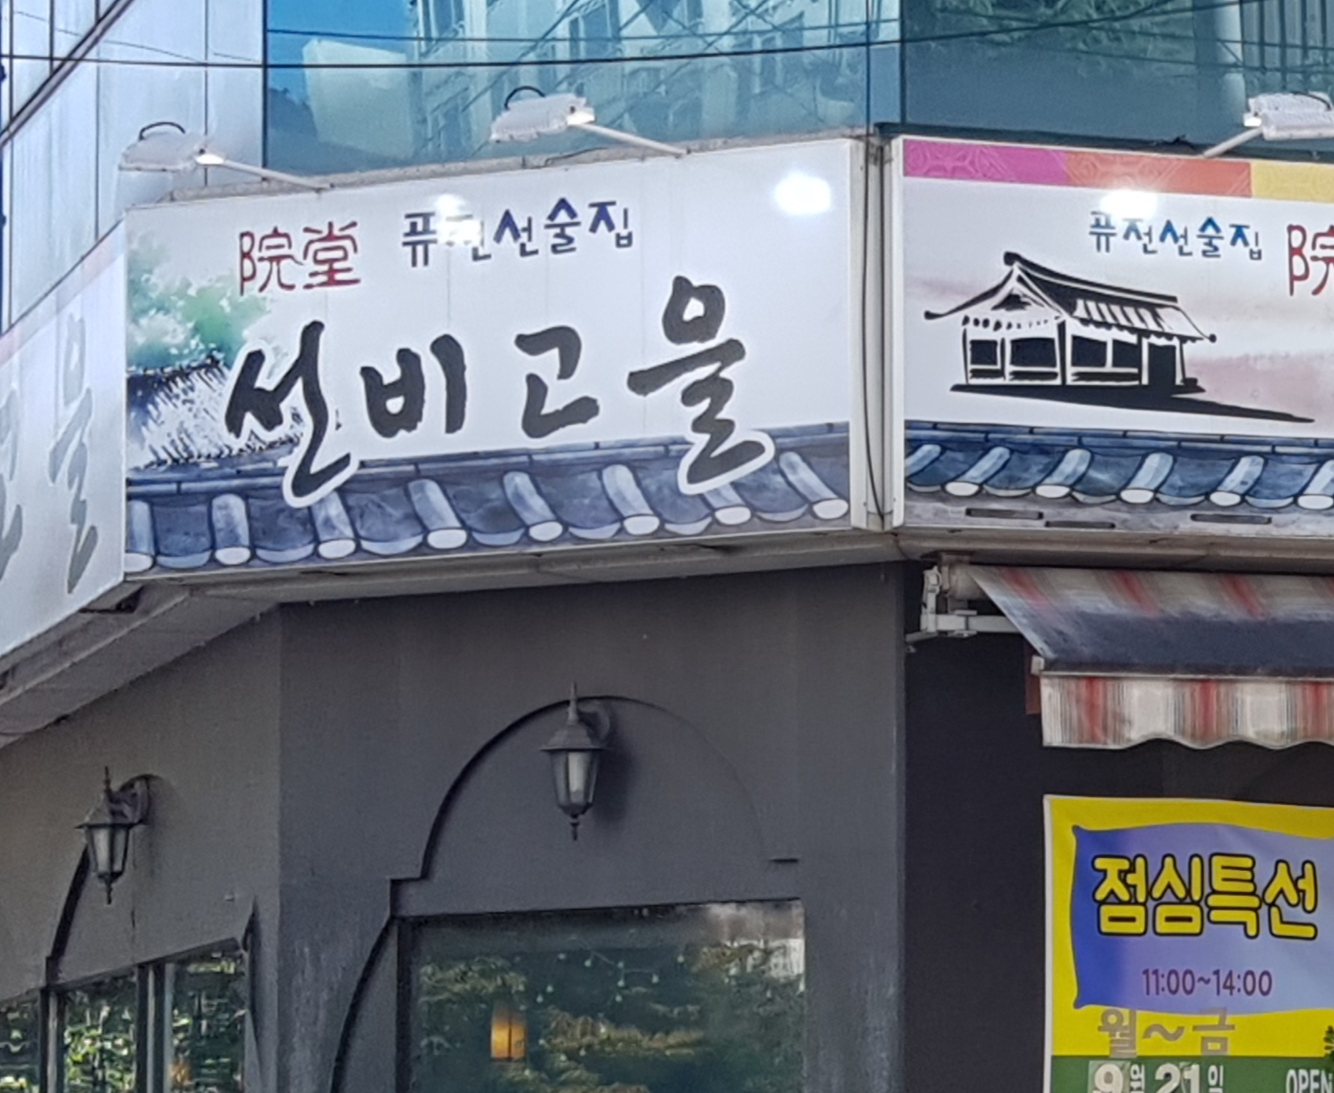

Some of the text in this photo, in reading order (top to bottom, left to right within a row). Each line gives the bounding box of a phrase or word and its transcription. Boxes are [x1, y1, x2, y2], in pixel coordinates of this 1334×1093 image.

[239, 221, 361, 296] 院堂
[1089, 210, 1263, 261] 퓨전선술집
[225, 275, 766, 498] 선비고을
[1092, 852, 1318, 940] 점심특선
[1141, 967, 1273, 997] 11:00~14:00
